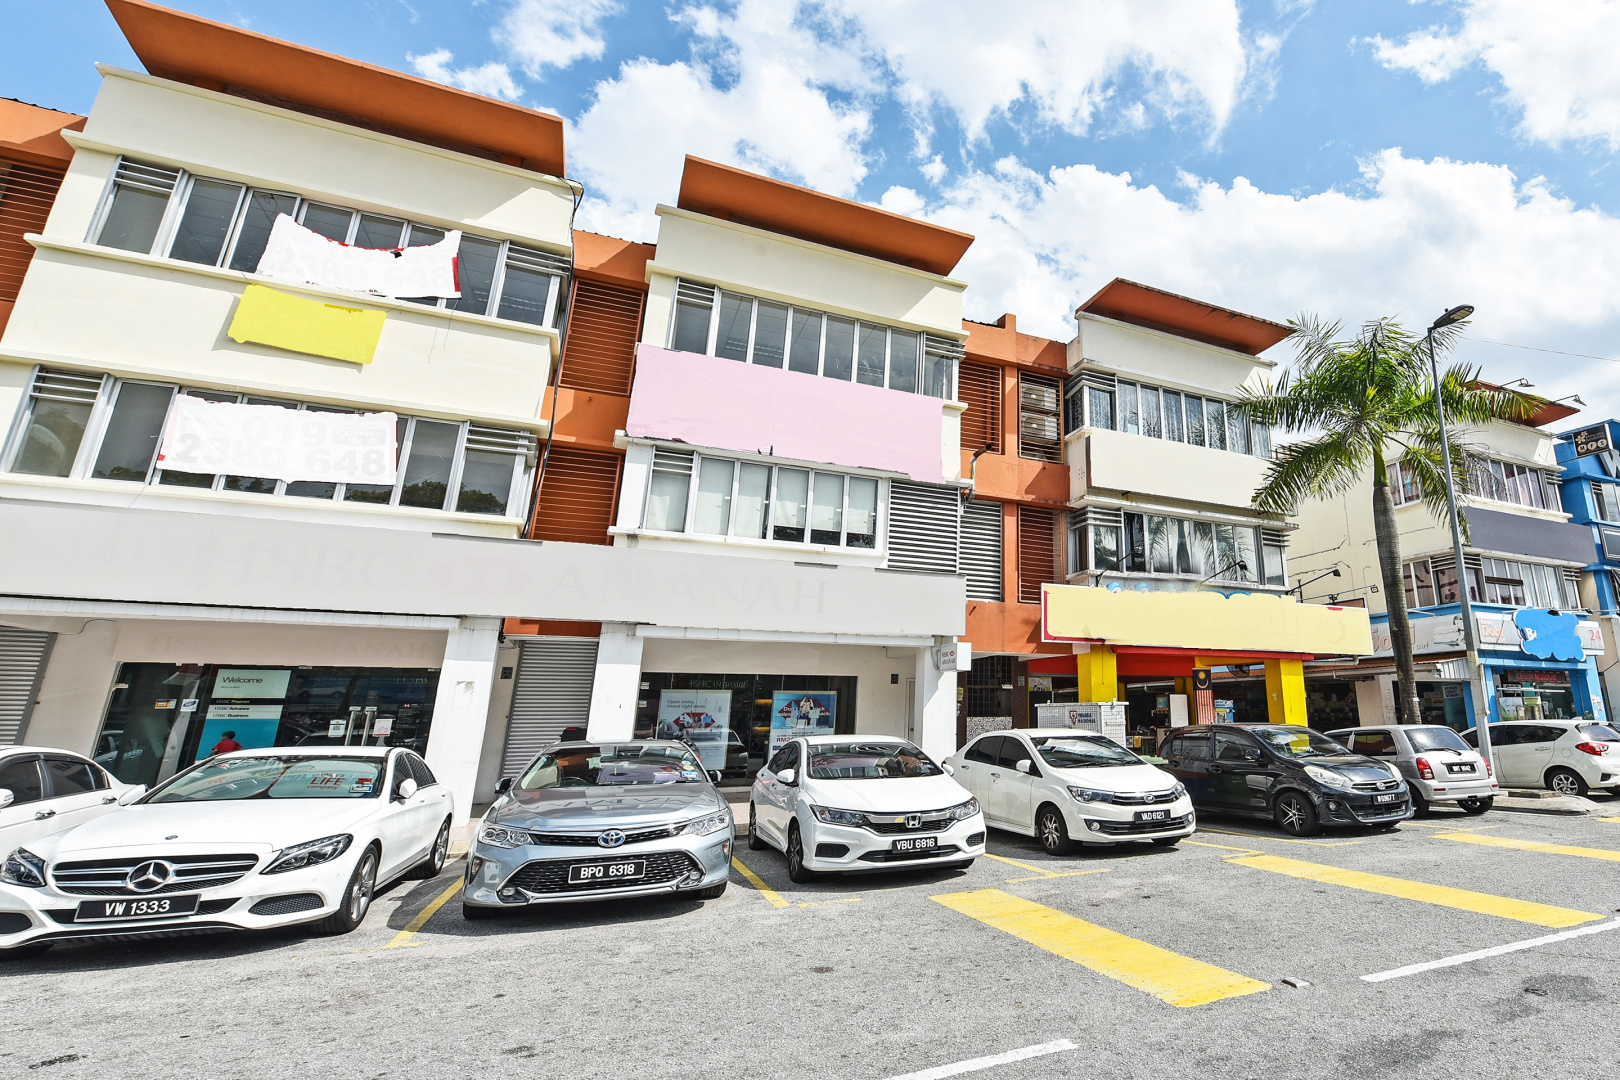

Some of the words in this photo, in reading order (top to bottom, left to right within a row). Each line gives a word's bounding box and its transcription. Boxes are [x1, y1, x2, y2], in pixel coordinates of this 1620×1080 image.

[1588, 629, 1602, 641] 24
[222, 676, 263, 684] Welcome
[310, 777, 346, 786] LIFE
[1152, 811, 1165, 820] 6121
[896, 840, 914, 850] VBU
[915, 838, 935, 849] 6816
[580, 866, 604, 879] BPQ
[609, 863, 635, 876] 6318
[105, 902, 126, 916] VW
[130, 899, 171, 916] 1333
